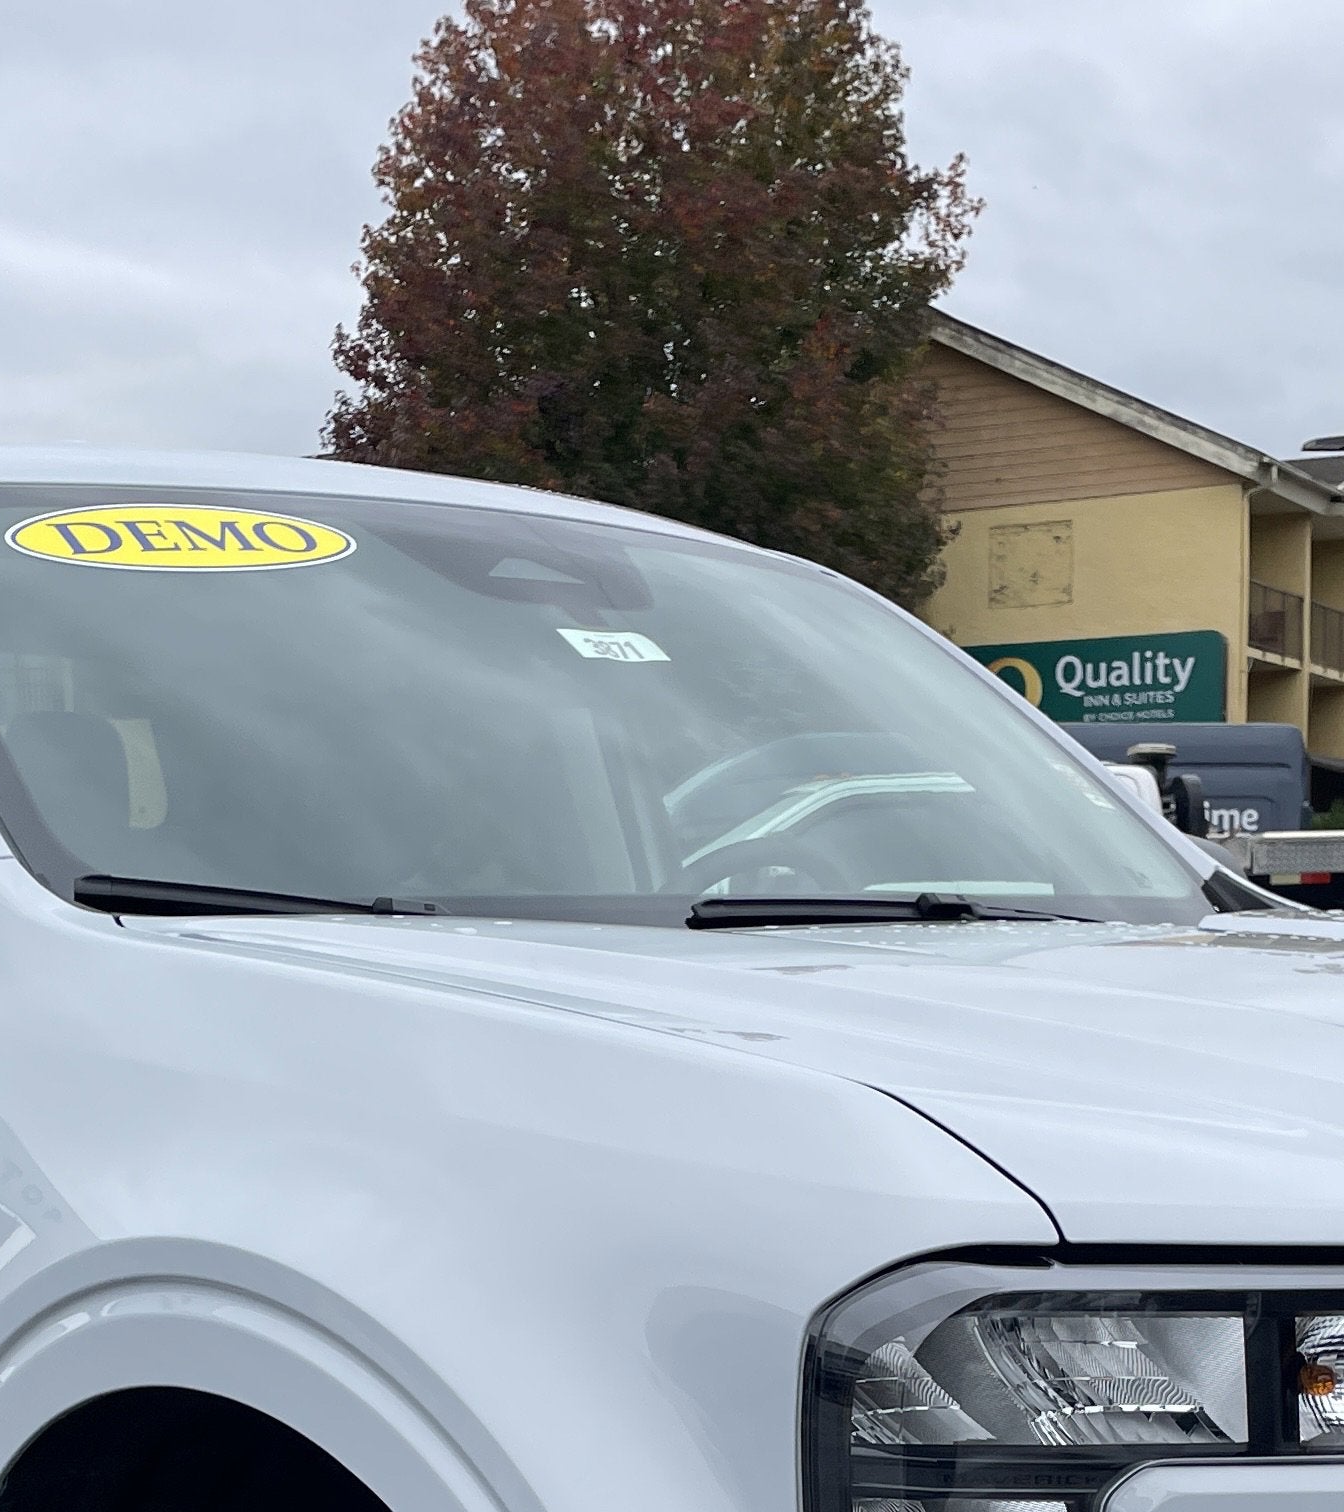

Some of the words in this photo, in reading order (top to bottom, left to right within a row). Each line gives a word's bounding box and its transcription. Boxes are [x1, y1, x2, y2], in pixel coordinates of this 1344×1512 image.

[45, 519, 317, 555] DEMO
[1055, 650, 1196, 697] Quality
[1083, 695, 1110, 707] INN
[1124, 690, 1175, 705] SUITES
[1202, 800, 1259, 831] ime
